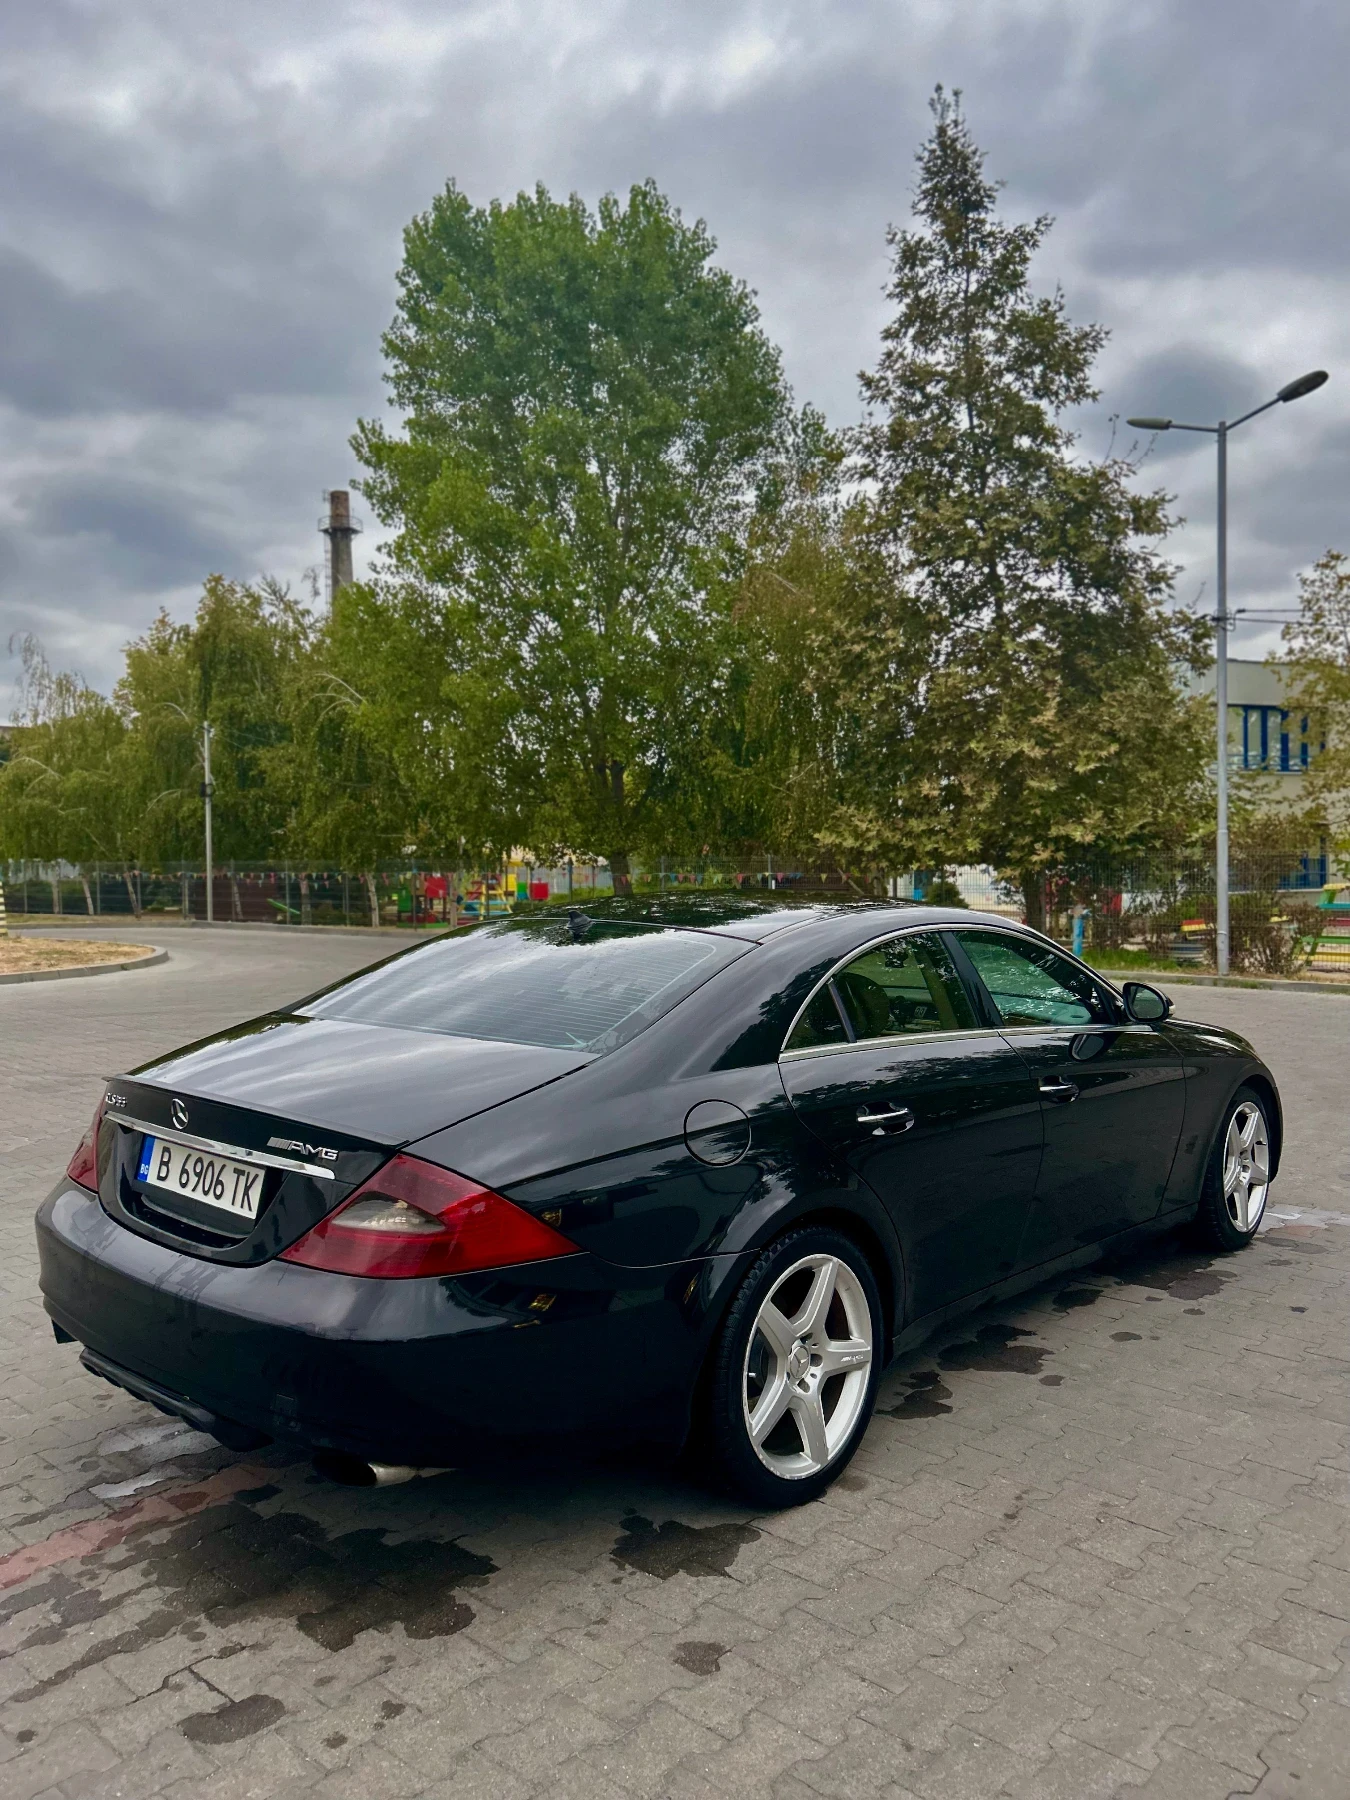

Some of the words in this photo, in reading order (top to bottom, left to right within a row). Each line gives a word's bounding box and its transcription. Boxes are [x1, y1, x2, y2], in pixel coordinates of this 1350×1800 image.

[287, 1140, 339, 1161] AMG
[140, 1163, 149, 1175] BG
[156, 1145, 172, 1182] B
[178, 1152, 227, 1201] 6906
[231, 1167, 259, 1212] TK
